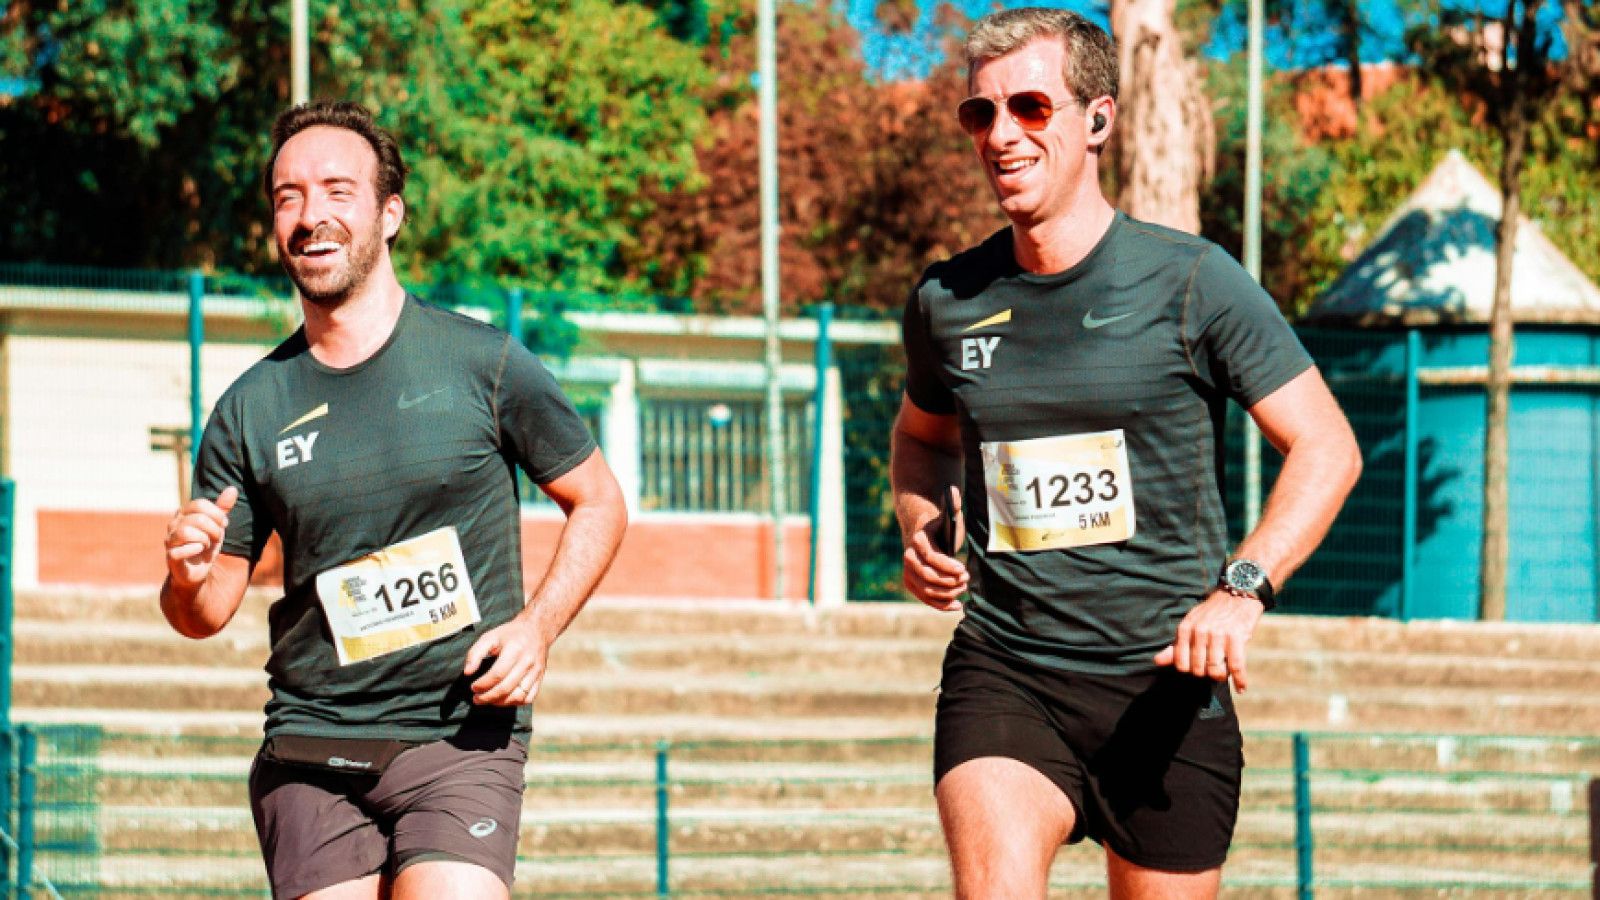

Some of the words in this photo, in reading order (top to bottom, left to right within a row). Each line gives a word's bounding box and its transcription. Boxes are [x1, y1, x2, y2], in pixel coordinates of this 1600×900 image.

[961, 336, 1001, 370] EY
[277, 431, 319, 469] EY
[1026, 469, 1118, 509] 1233
[1078, 513, 1087, 530] 5
[1091, 511, 1111, 529] KM
[375, 563, 458, 613] 1266
[429, 608, 439, 624] 5
[439, 601, 457, 620] KM
